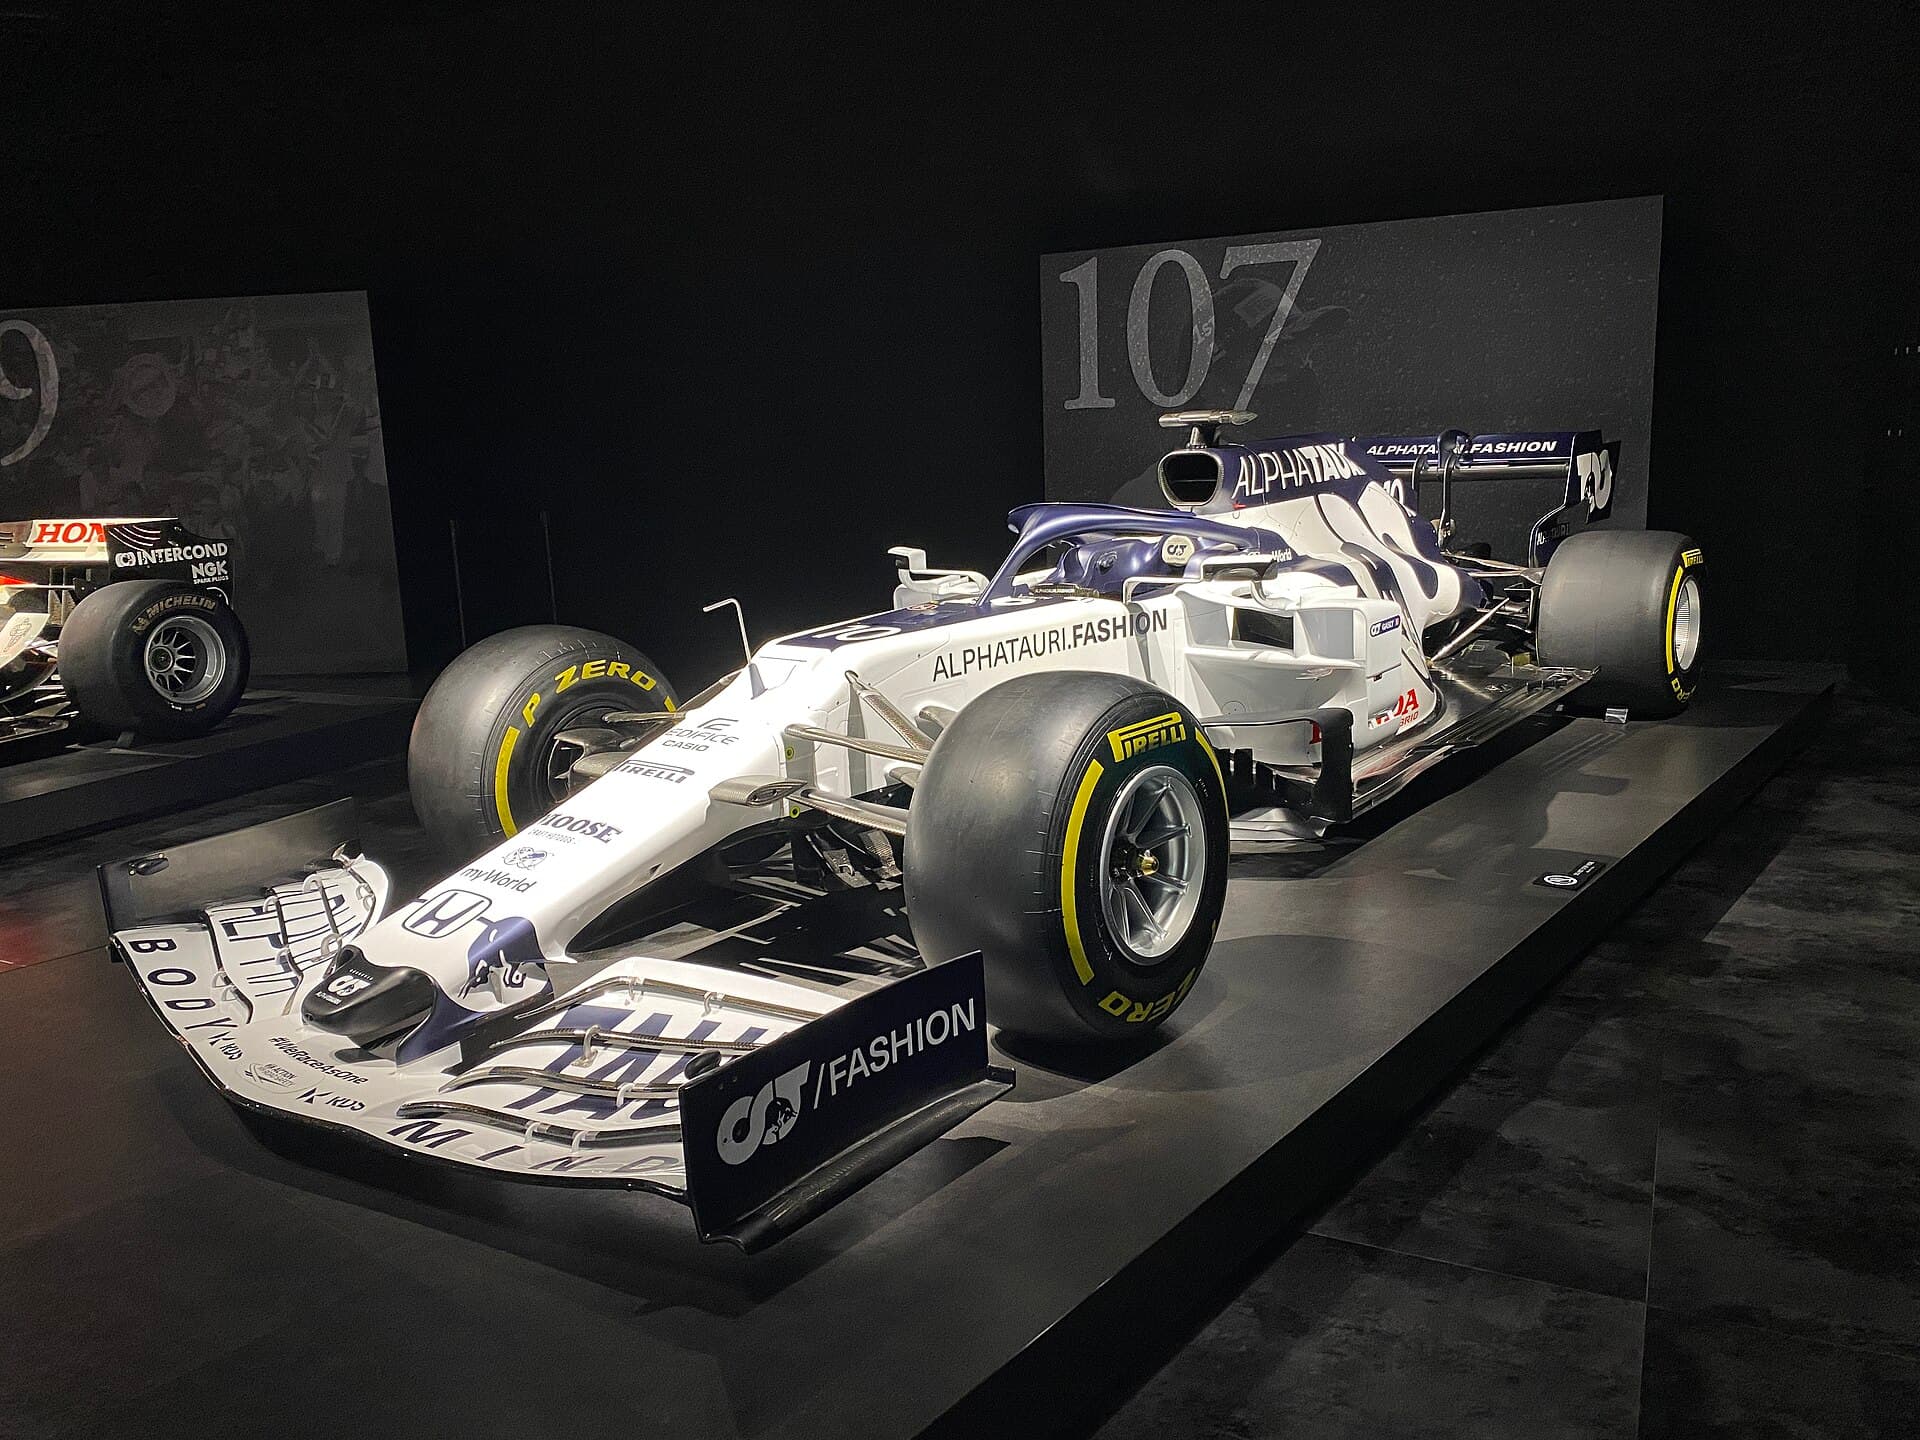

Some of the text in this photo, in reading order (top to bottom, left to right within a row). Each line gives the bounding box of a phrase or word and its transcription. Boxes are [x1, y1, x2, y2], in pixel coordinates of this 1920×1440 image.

[1059, 238, 1322, 412] 107
[137, 542, 229, 566] INTERCOND
[191, 560, 228, 579] NGK
[146, 595, 216, 618] MICHELIN
[933, 608, 1168, 683] ALPHATAURI.FASHION
[554, 659, 657, 694] ZERO
[661, 739, 710, 752] CASIO
[665, 728, 740, 746] EDIFICE
[1106, 711, 1187, 763] PIRELLI
[614, 759, 696, 784] PIRELLI
[460, 867, 538, 893] myWorld
[128, 938, 239, 1030] BODY
[268, 1036, 369, 1085] #WeRaceAsOne
[386, 1119, 679, 1173] MIND
